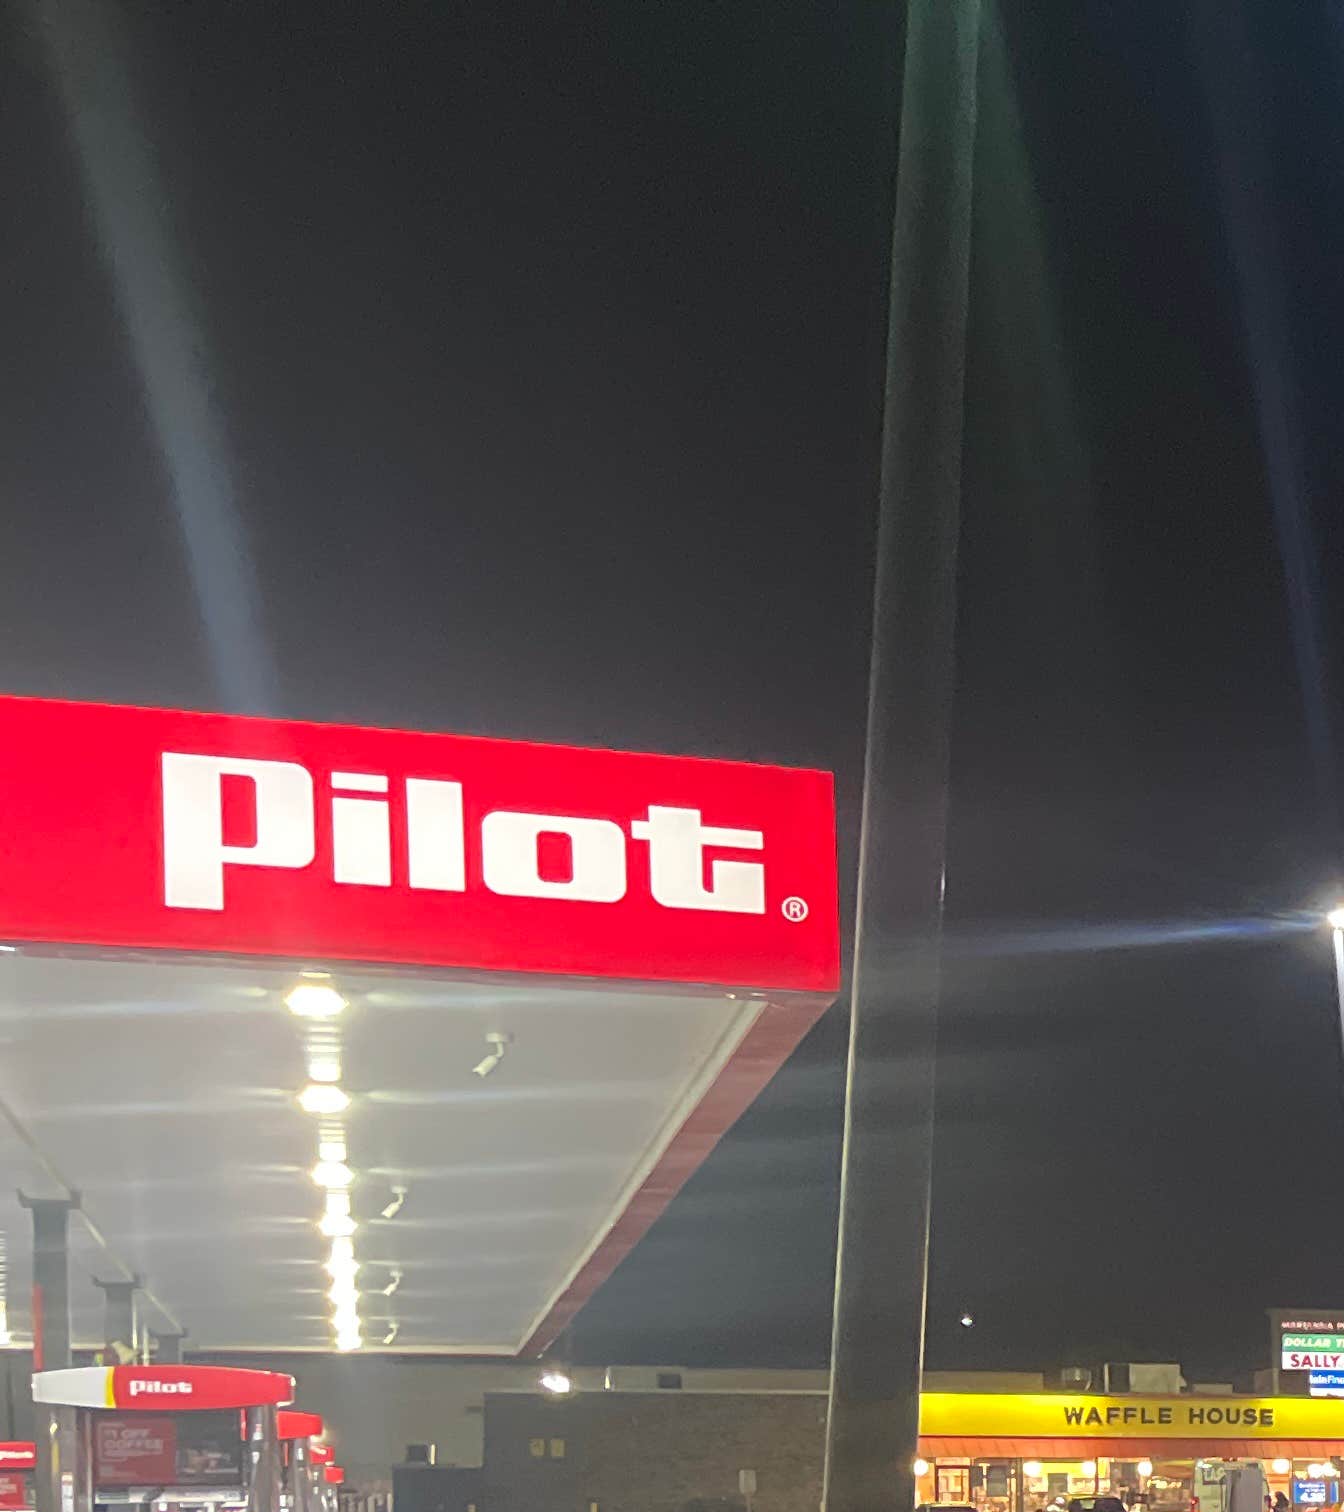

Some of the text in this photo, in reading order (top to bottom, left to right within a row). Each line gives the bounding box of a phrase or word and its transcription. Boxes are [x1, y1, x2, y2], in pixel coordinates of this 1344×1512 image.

[1284, 1337, 1331, 1347] DOLLAR
[1290, 1354, 1340, 1368] SALLY
[1064, 1407, 1274, 1426] WAFFLE HOUSE
